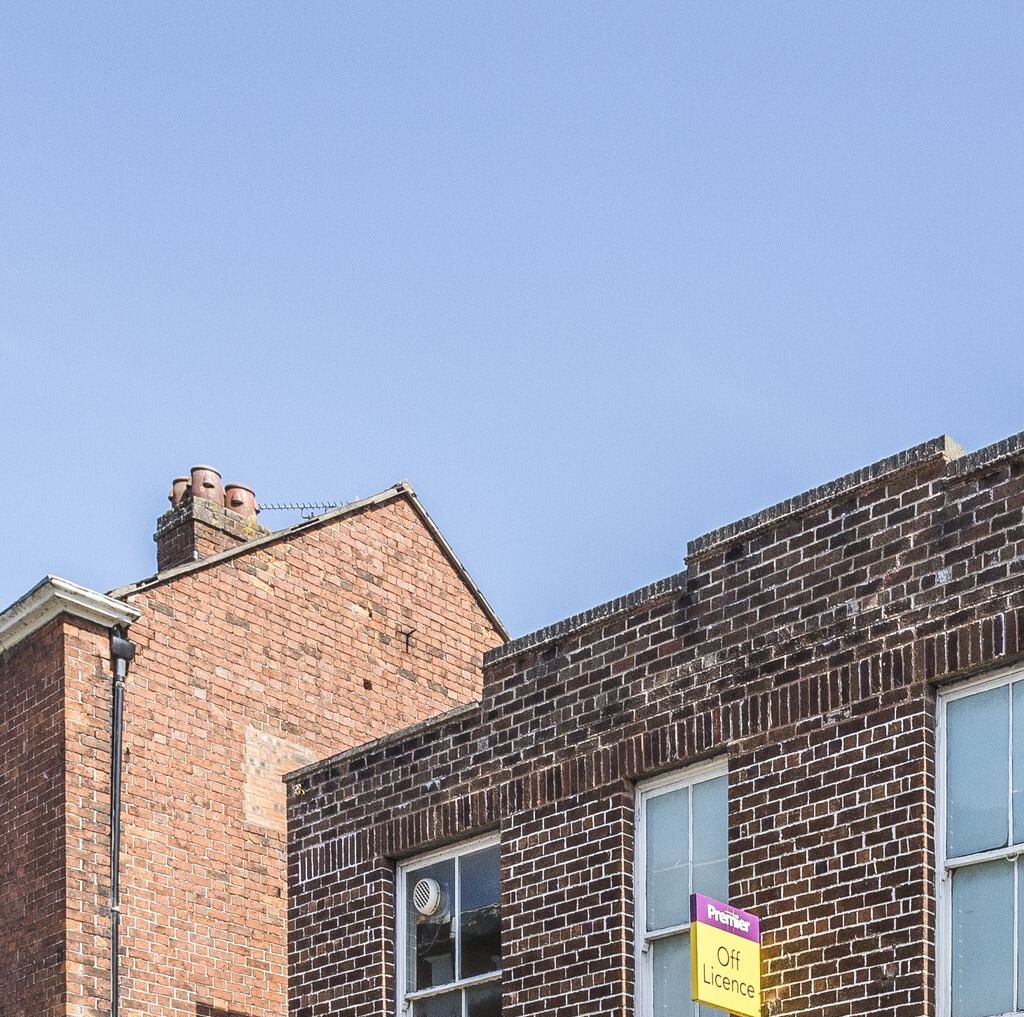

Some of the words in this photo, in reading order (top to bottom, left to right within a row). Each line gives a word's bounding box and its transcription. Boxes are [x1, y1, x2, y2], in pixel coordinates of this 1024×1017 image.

[707, 903, 750, 933] Premier
[717, 946, 741, 971] Off
[703, 963, 755, 999] Licence
